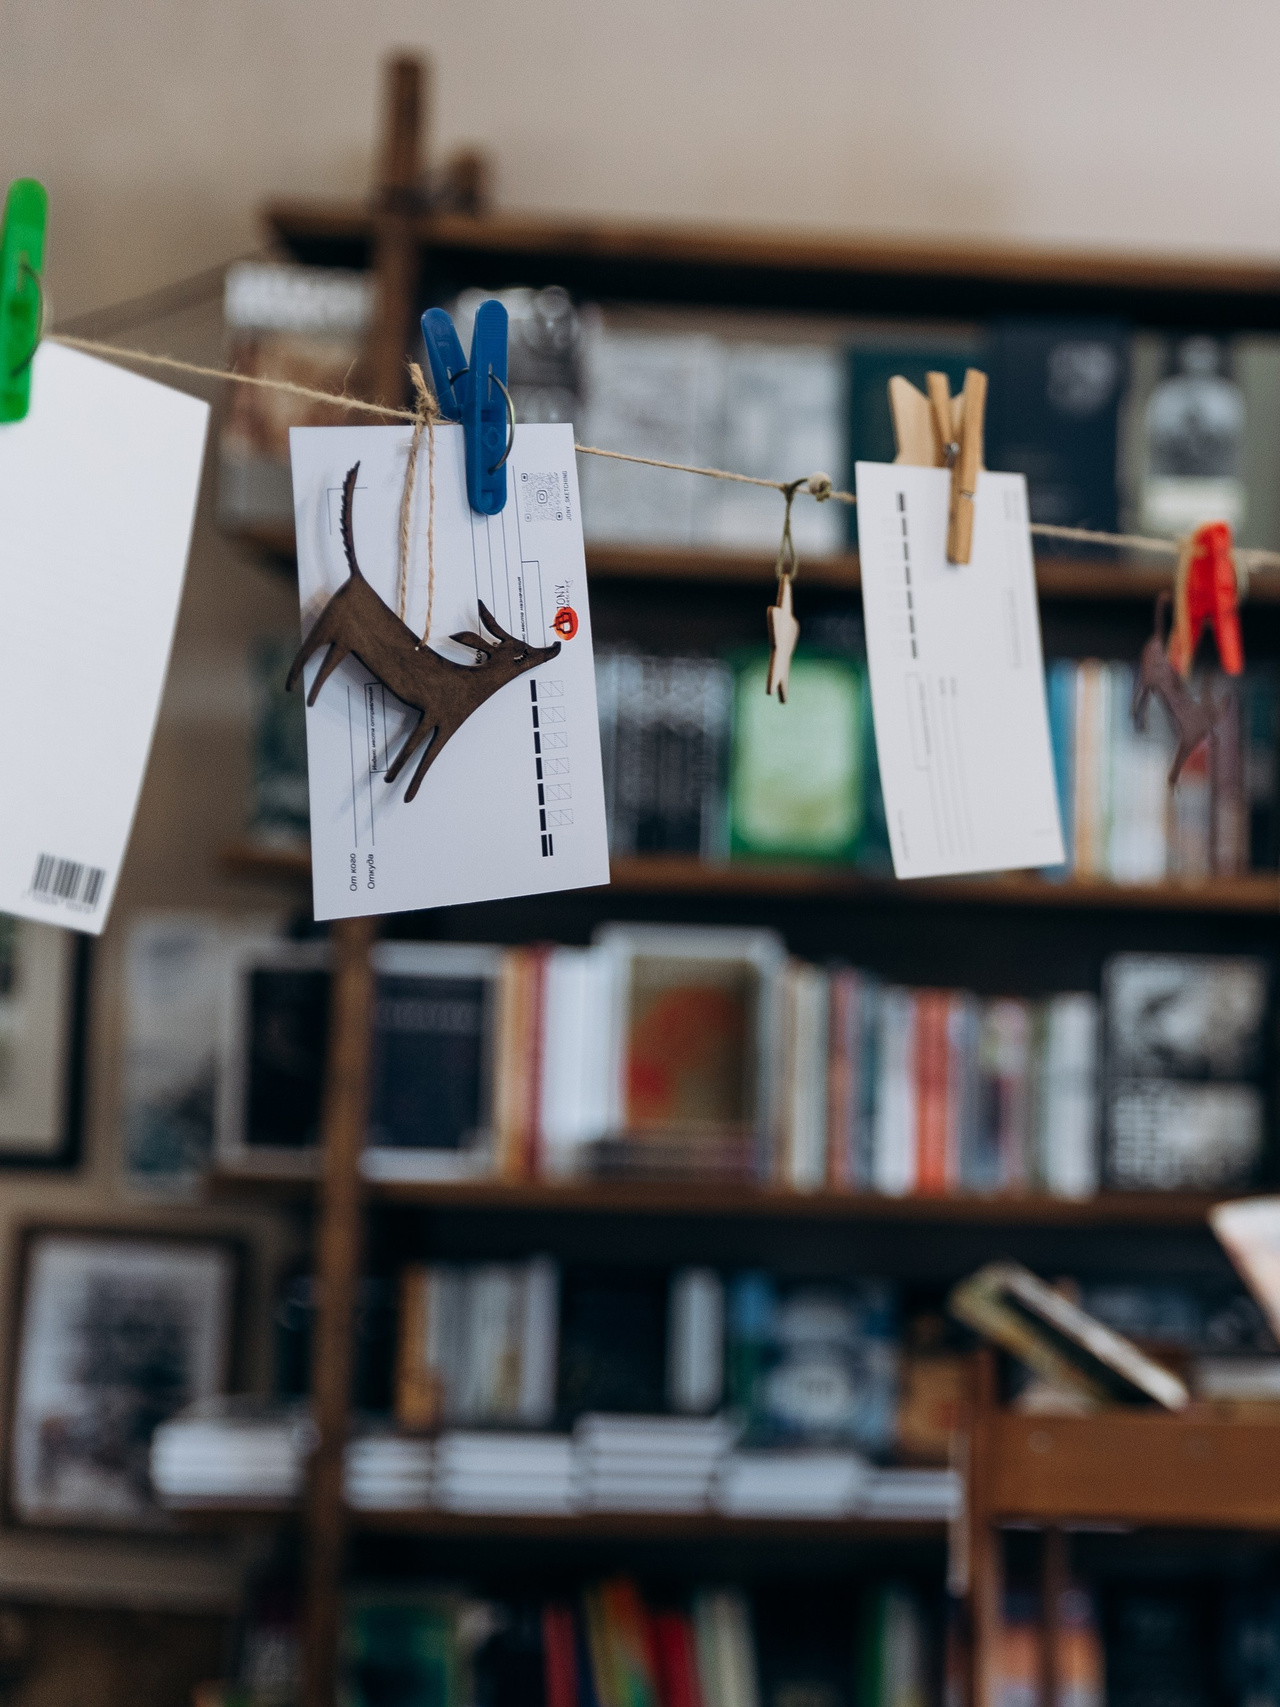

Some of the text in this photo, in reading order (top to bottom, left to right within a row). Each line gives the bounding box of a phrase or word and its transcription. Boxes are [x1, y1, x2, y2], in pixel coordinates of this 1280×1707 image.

[563, 470, 571, 521] JONY_SKETCHING
[349, 876, 357, 891] От
[367, 854, 375, 889] Откуда
